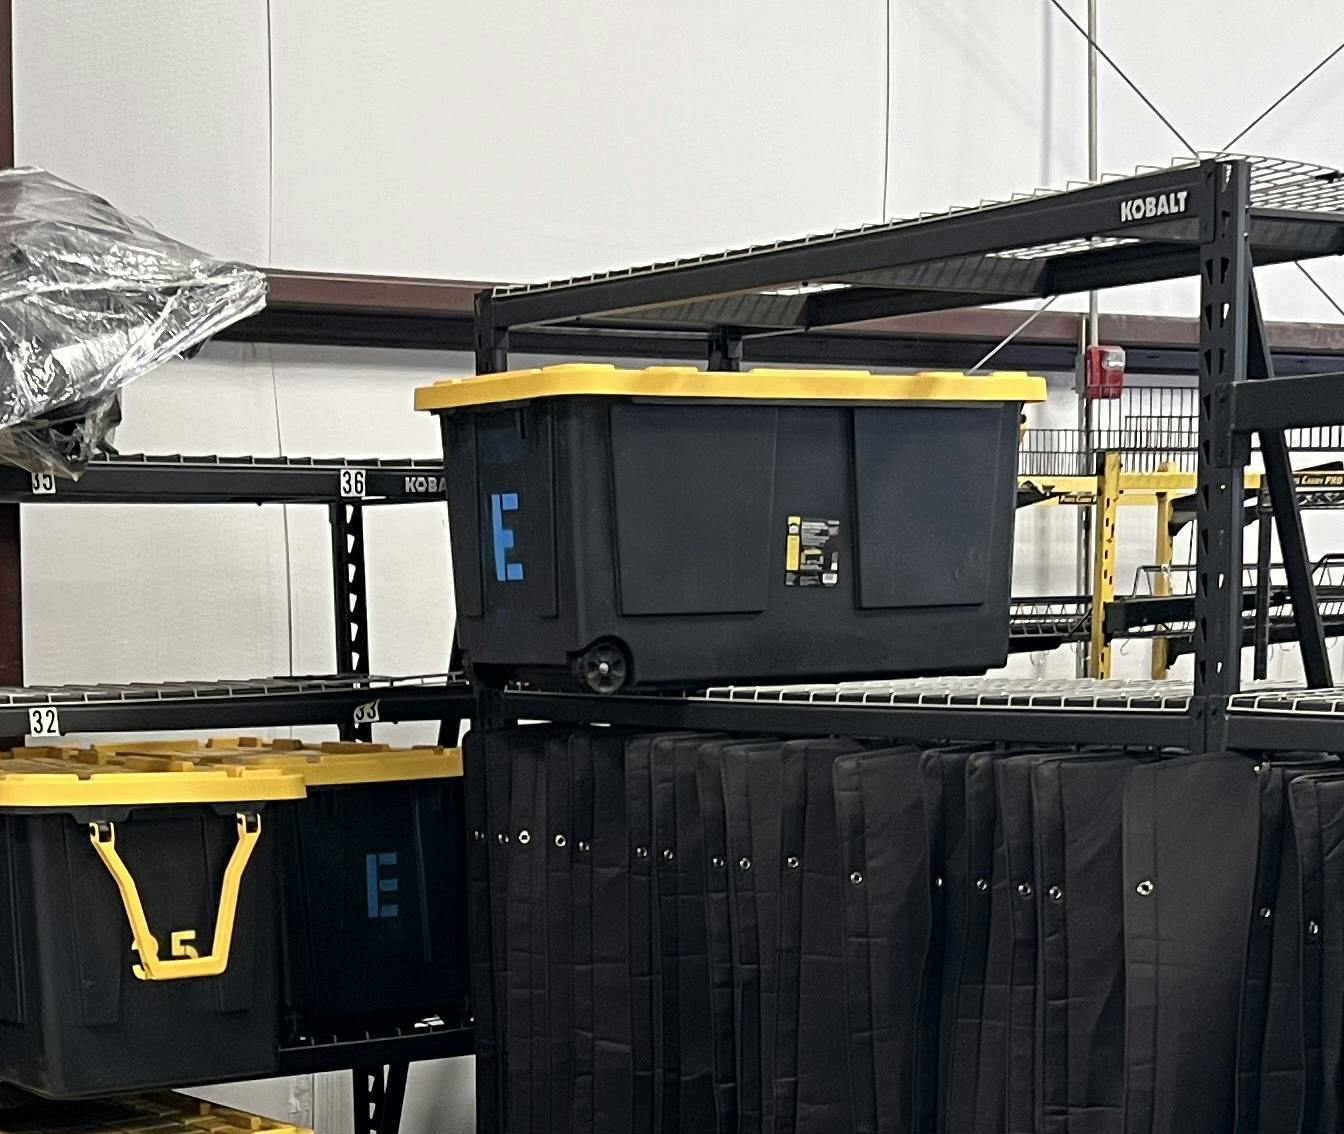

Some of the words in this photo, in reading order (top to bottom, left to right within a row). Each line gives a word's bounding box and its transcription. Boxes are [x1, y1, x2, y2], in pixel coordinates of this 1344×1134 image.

[1120, 190, 1188, 222] KOBALT
[342, 471, 364, 494] 36
[404, 476, 448, 493] KOBA
[491, 493, 524, 582] E
[32, 709, 57, 734] 32
[365, 851, 399, 918] E
